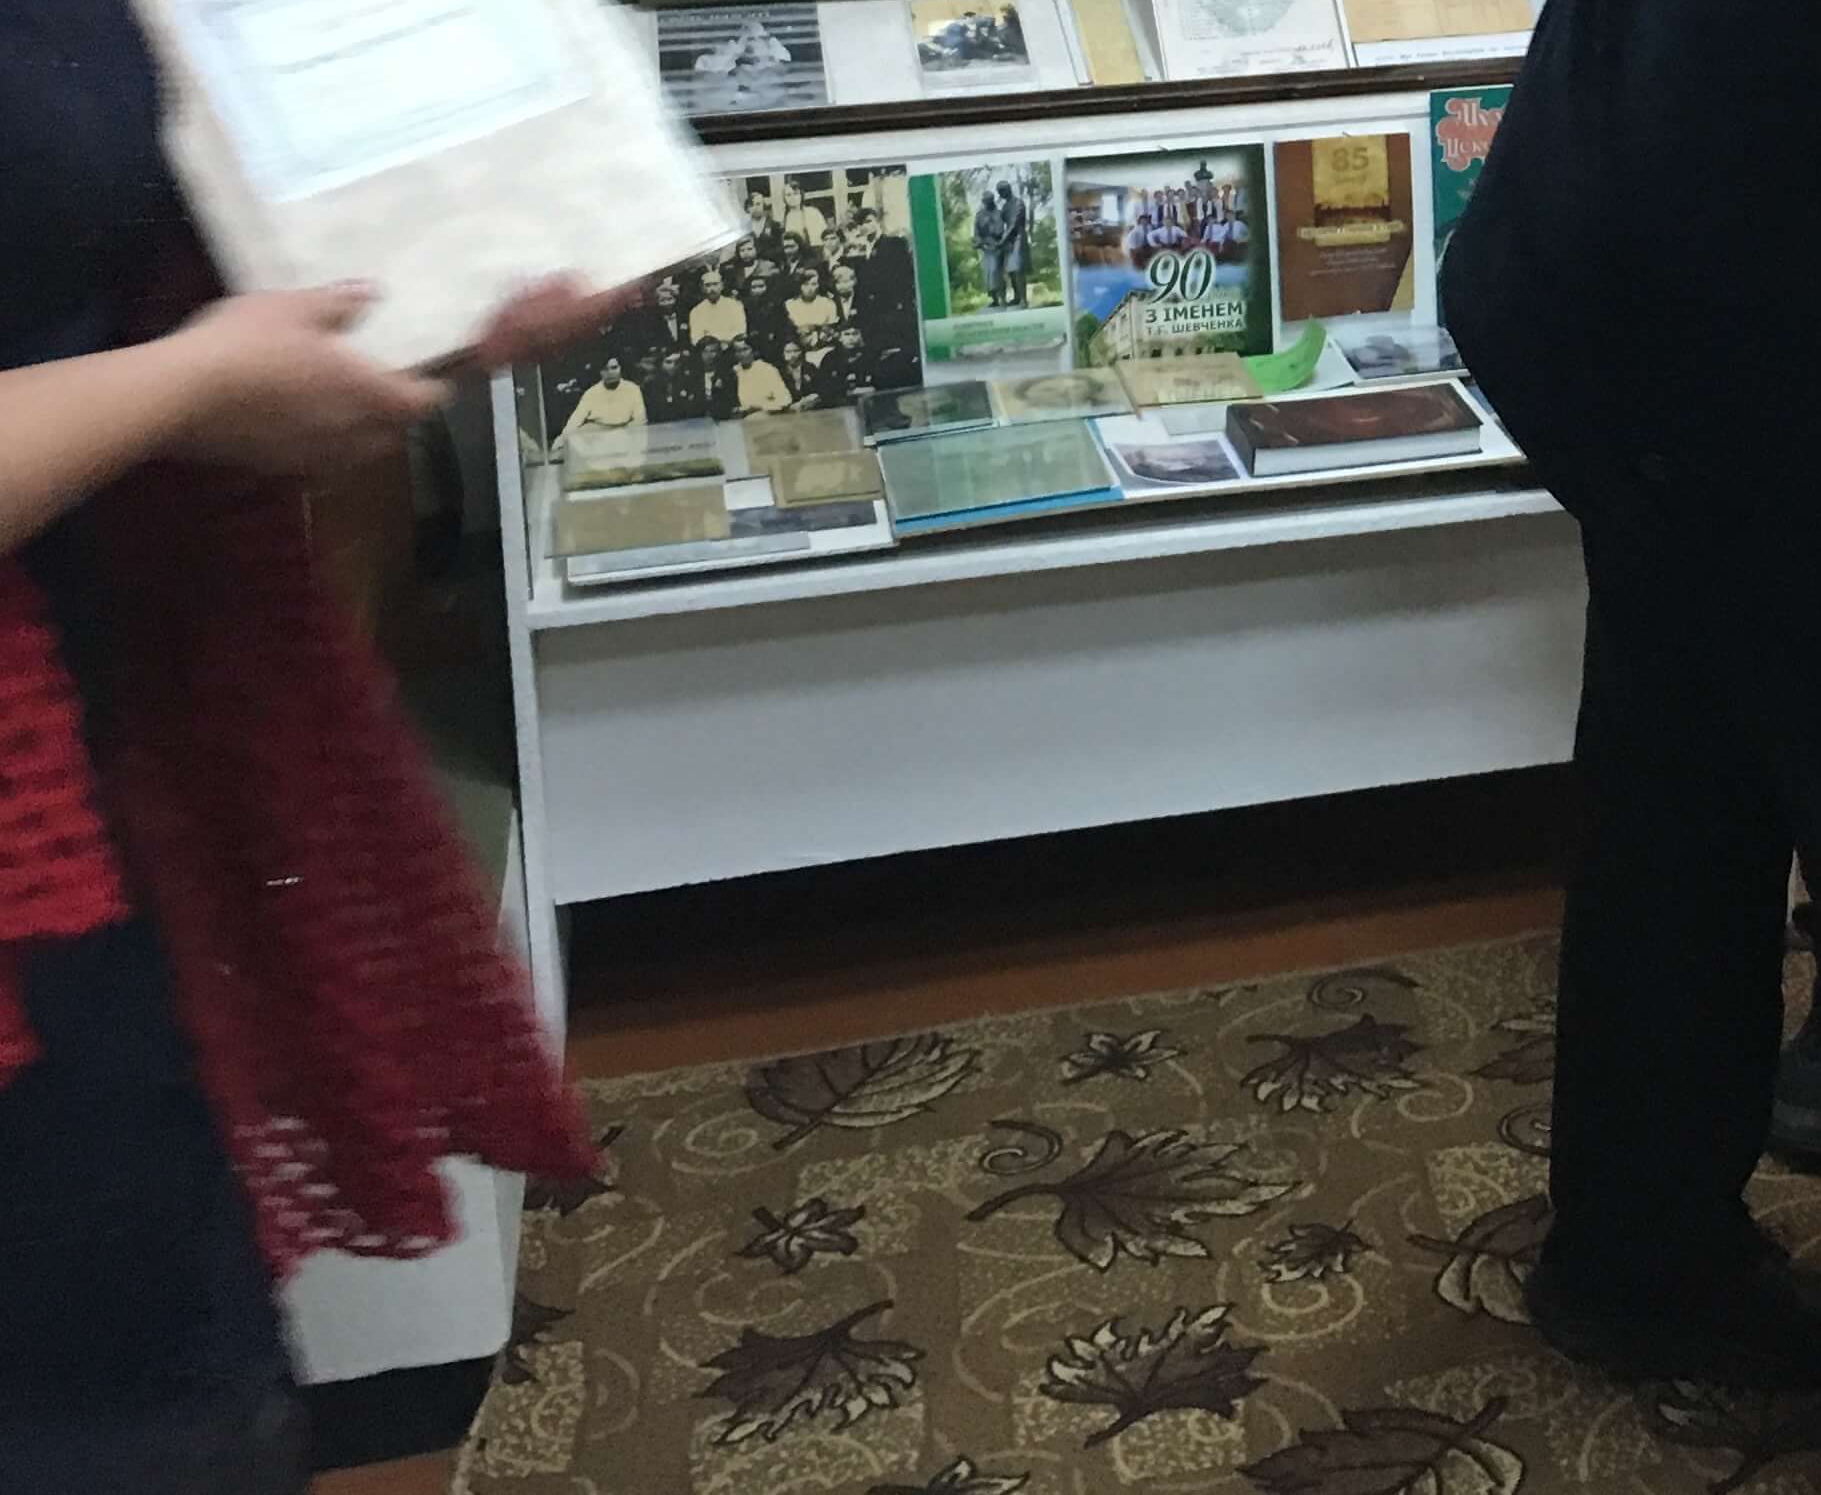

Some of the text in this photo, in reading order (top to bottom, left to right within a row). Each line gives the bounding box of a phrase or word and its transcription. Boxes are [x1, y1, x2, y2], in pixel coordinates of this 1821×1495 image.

[1331, 147, 1369, 172] 85
[1147, 249, 1213, 305] 90
[1145, 302, 1242, 324] З ІМЕНЕМ
[1171, 318, 1242, 334] ШЕВЧЕНКА
